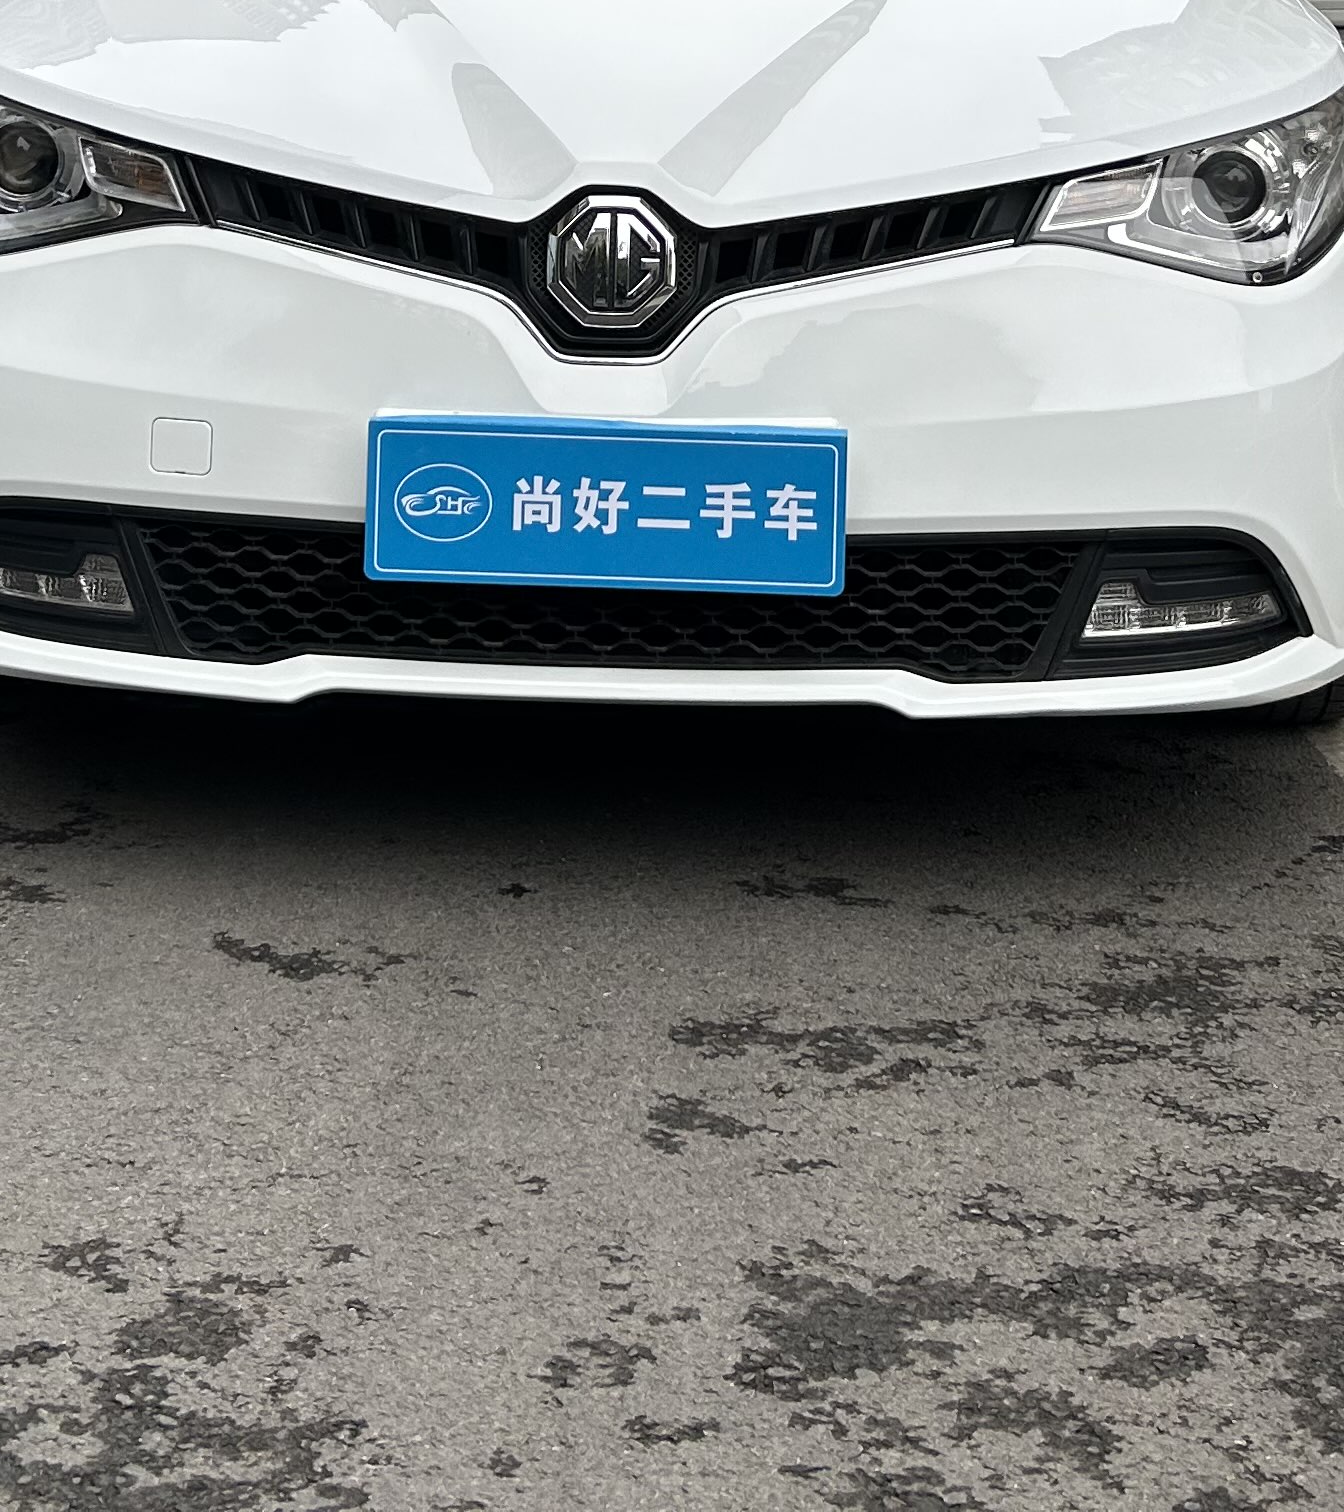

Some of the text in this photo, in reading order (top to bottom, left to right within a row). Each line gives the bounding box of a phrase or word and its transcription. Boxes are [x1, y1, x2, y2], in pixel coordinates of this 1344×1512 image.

[564, 212, 661, 308] MG
[511, 474, 818, 541] 尚好二手车
